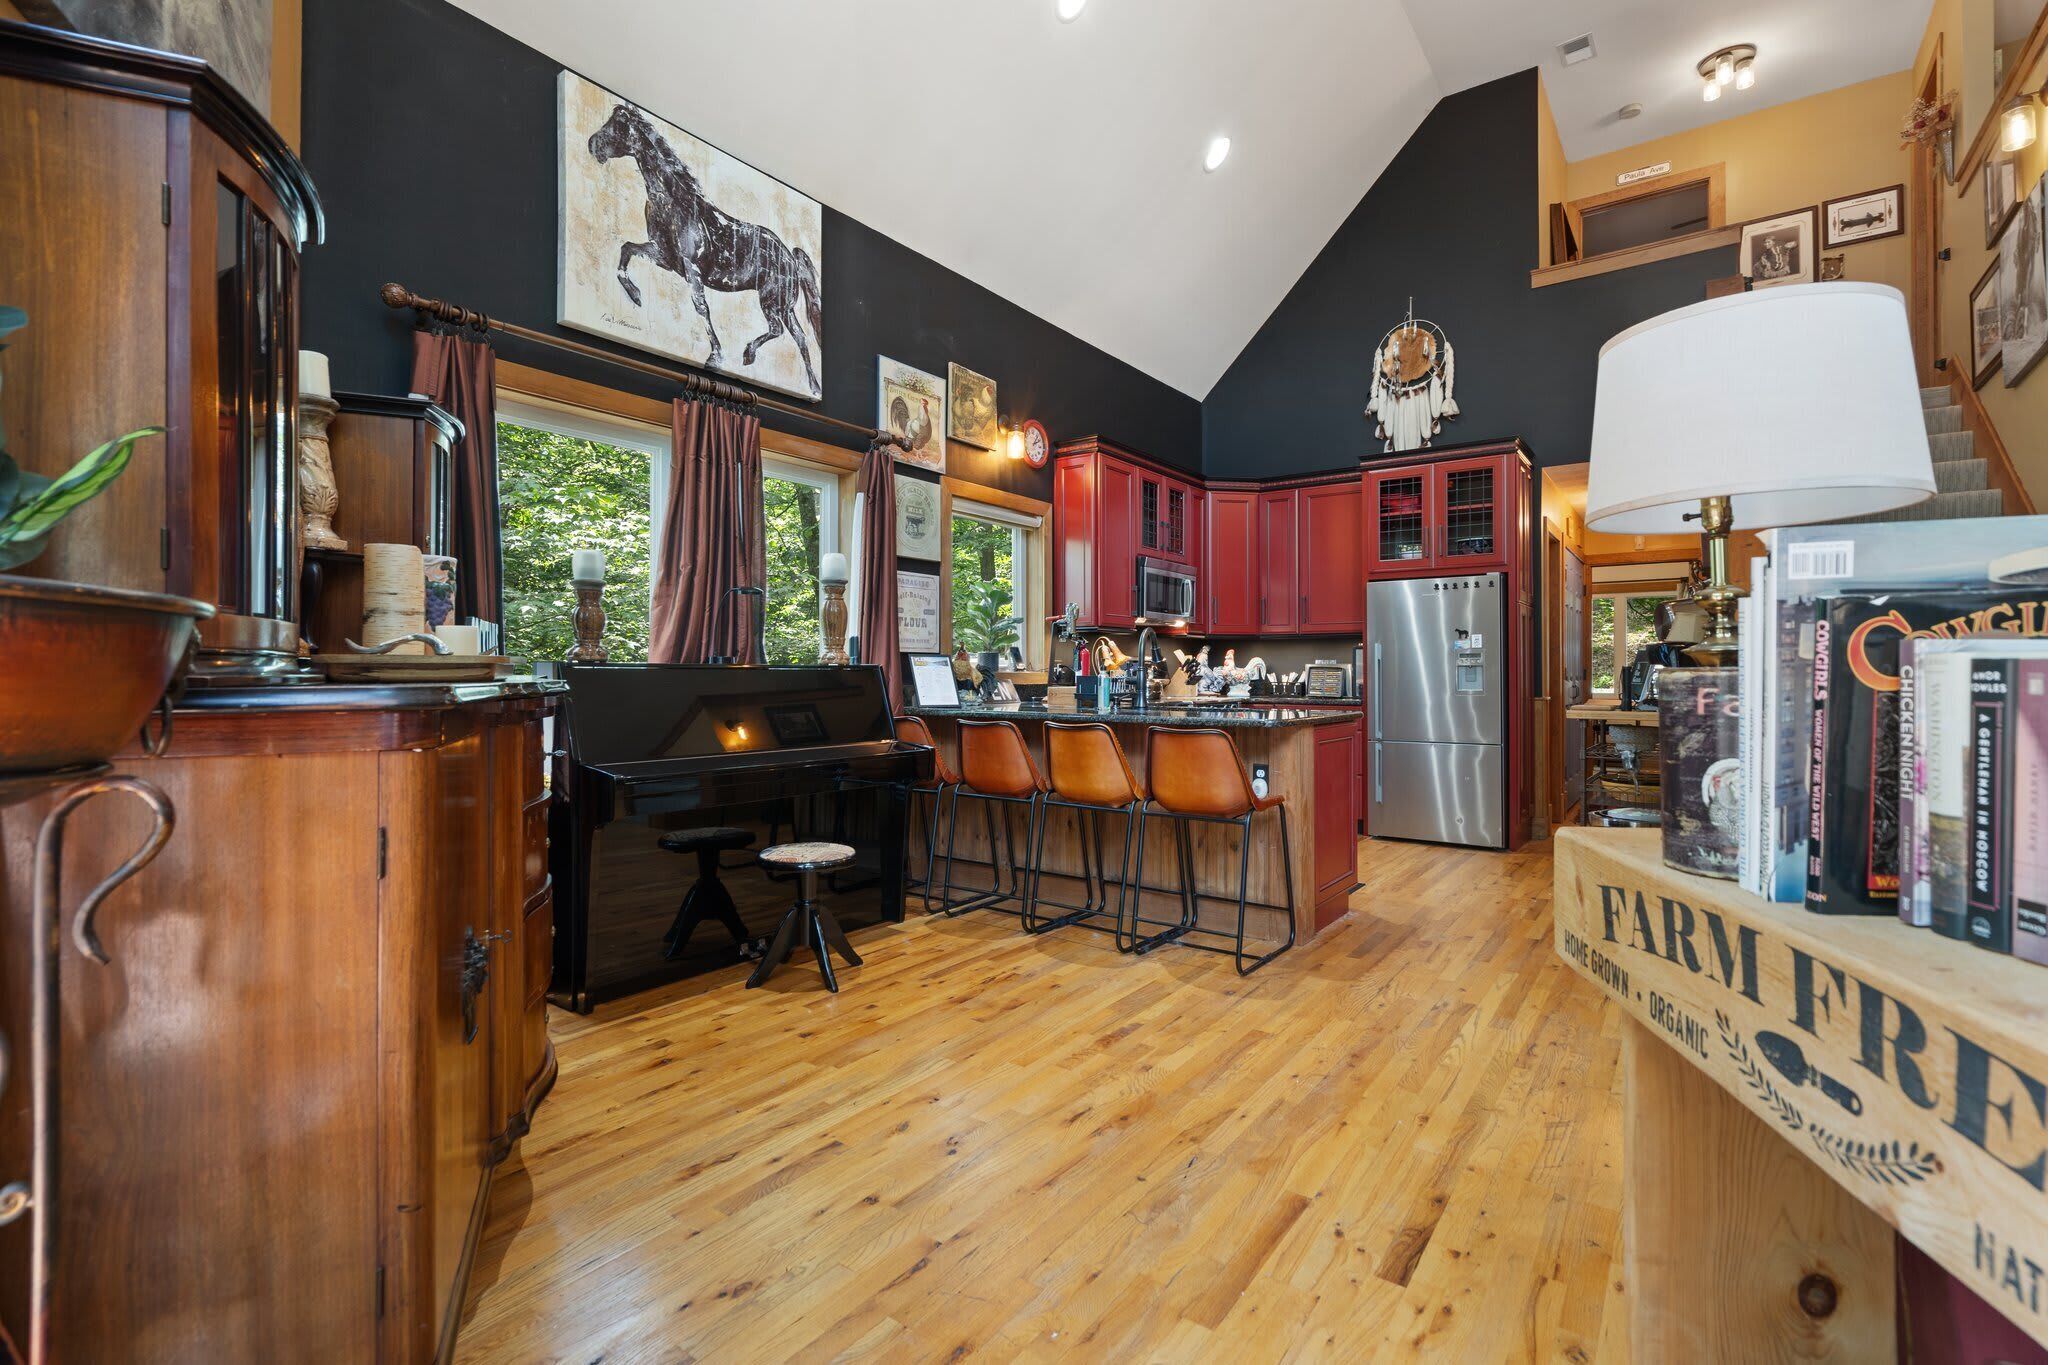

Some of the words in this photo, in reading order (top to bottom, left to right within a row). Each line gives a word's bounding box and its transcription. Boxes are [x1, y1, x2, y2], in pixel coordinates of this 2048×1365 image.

[1624, 170, 1646, 180] Paula
[1813, 619, 1830, 701] COWGIRLS
[1813, 708, 1825, 743] WOMEN
[1900, 664, 1914, 747] CHICKEN
[1978, 713, 1991, 723] A
[1813, 743, 1823, 758] OF
[1930, 682, 1943, 802] WASHINGTON
[1812, 762, 1823, 783] THE
[1900, 749, 1914, 801] NIGHT
[1976, 727, 1992, 806] GENTLEMAN
[1811, 785, 1822, 814] WILD
[1976, 810, 1990, 826] IN
[1810, 815, 1821, 842] WEST
[1975, 829, 1990, 893] MOSCOW
[1564, 929, 1589, 969] HOME
[1591, 949, 1630, 999] GROWN
[1649, 990, 1709, 1060] ORGANIC
[1597, 884, 1766, 1007] FARM
[1786, 942, 2048, 1194] FRE
